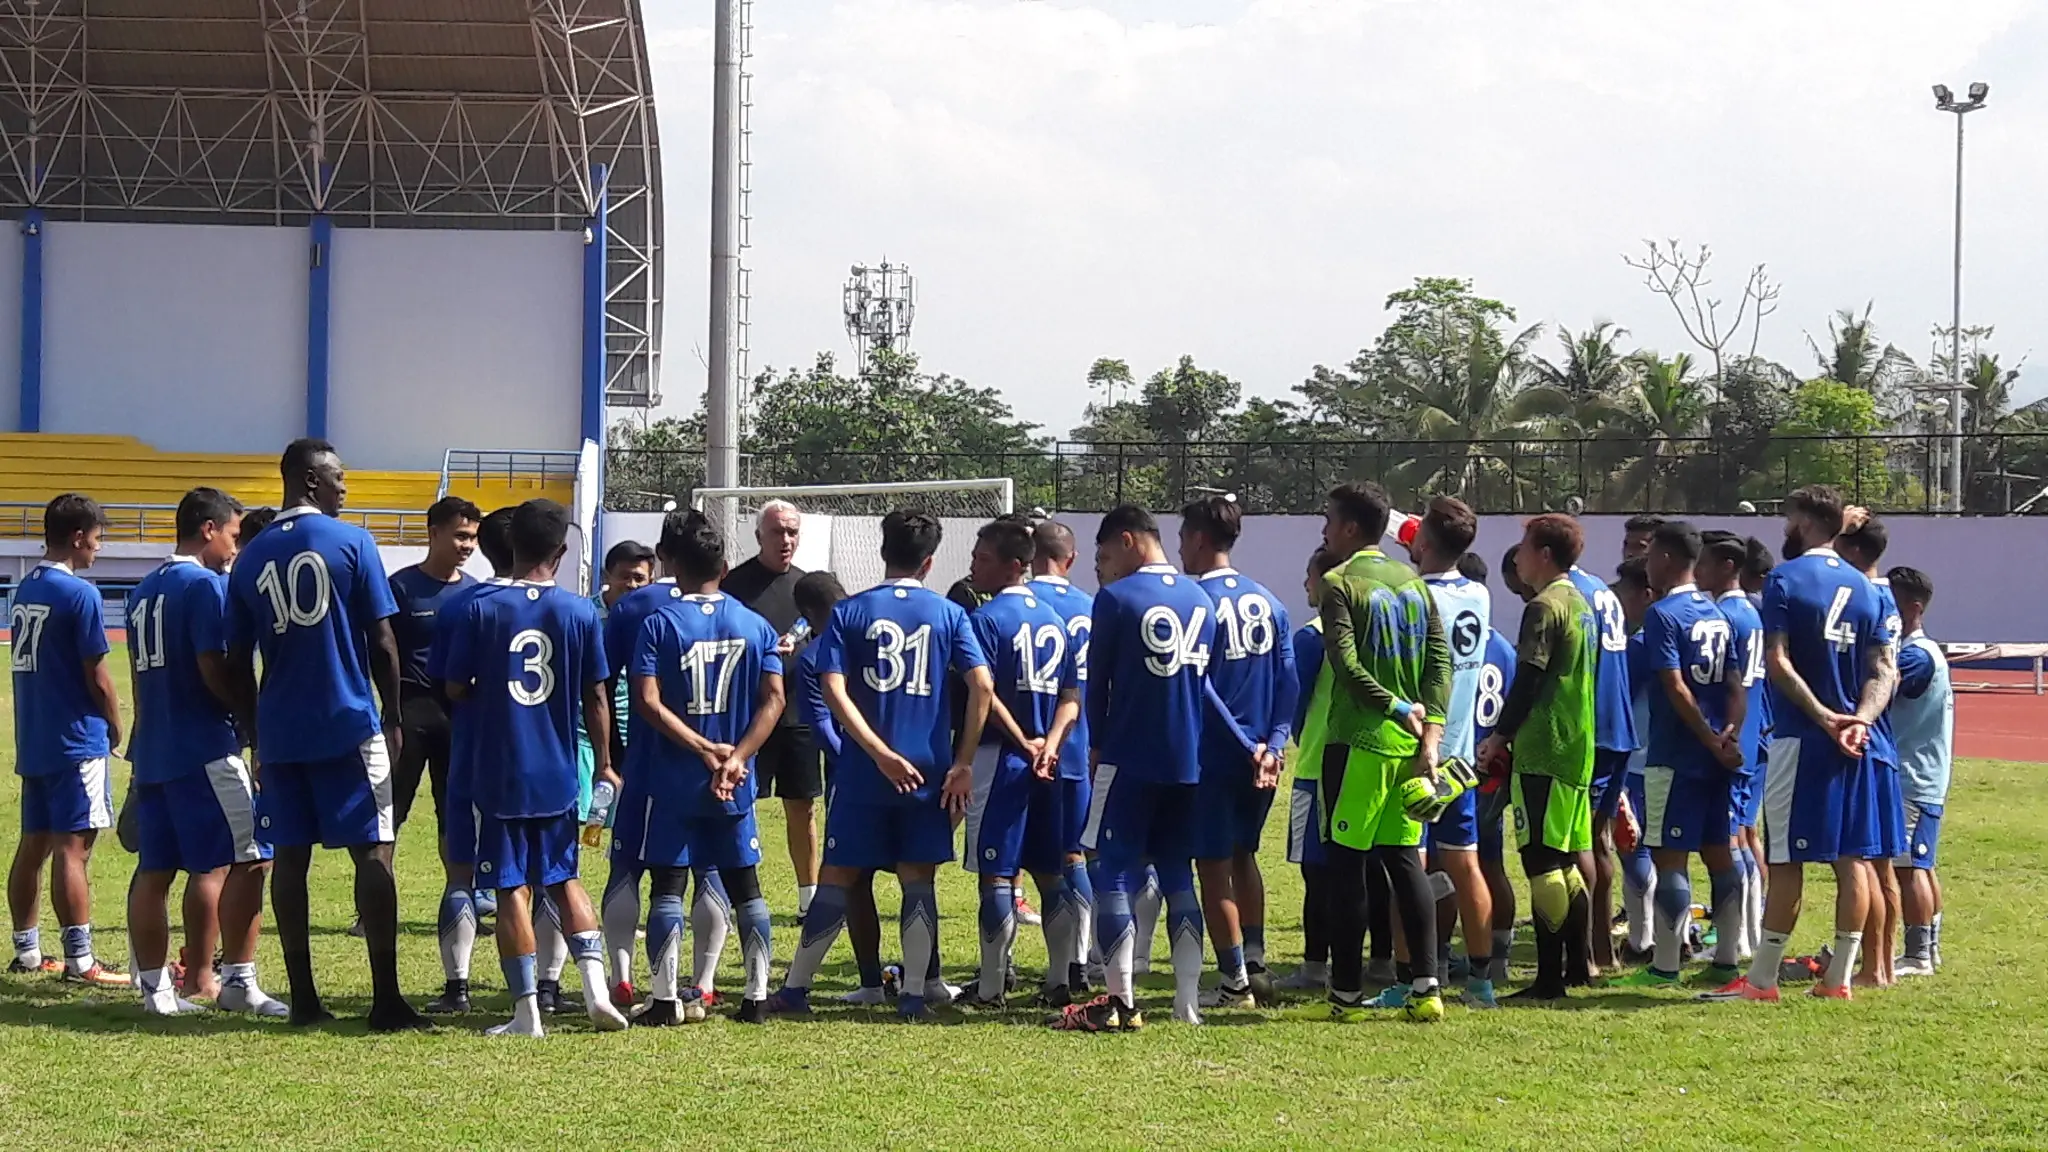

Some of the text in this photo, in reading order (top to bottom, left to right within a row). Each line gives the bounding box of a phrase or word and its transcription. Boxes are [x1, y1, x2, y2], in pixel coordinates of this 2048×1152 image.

[256, 550, 330, 635] 10
[1215, 593, 1274, 661] 18
[1824, 586, 1856, 653] 4
[11, 604, 51, 673] 27
[131, 594, 165, 672] 11
[507, 629, 555, 706] 3
[862, 619, 932, 696] 31
[1012, 622, 1065, 695] 12
[1141, 605, 1210, 677] 94
[1690, 619, 1730, 685] 37
[680, 638, 746, 715] 17
[1476, 663, 1504, 728] 8
